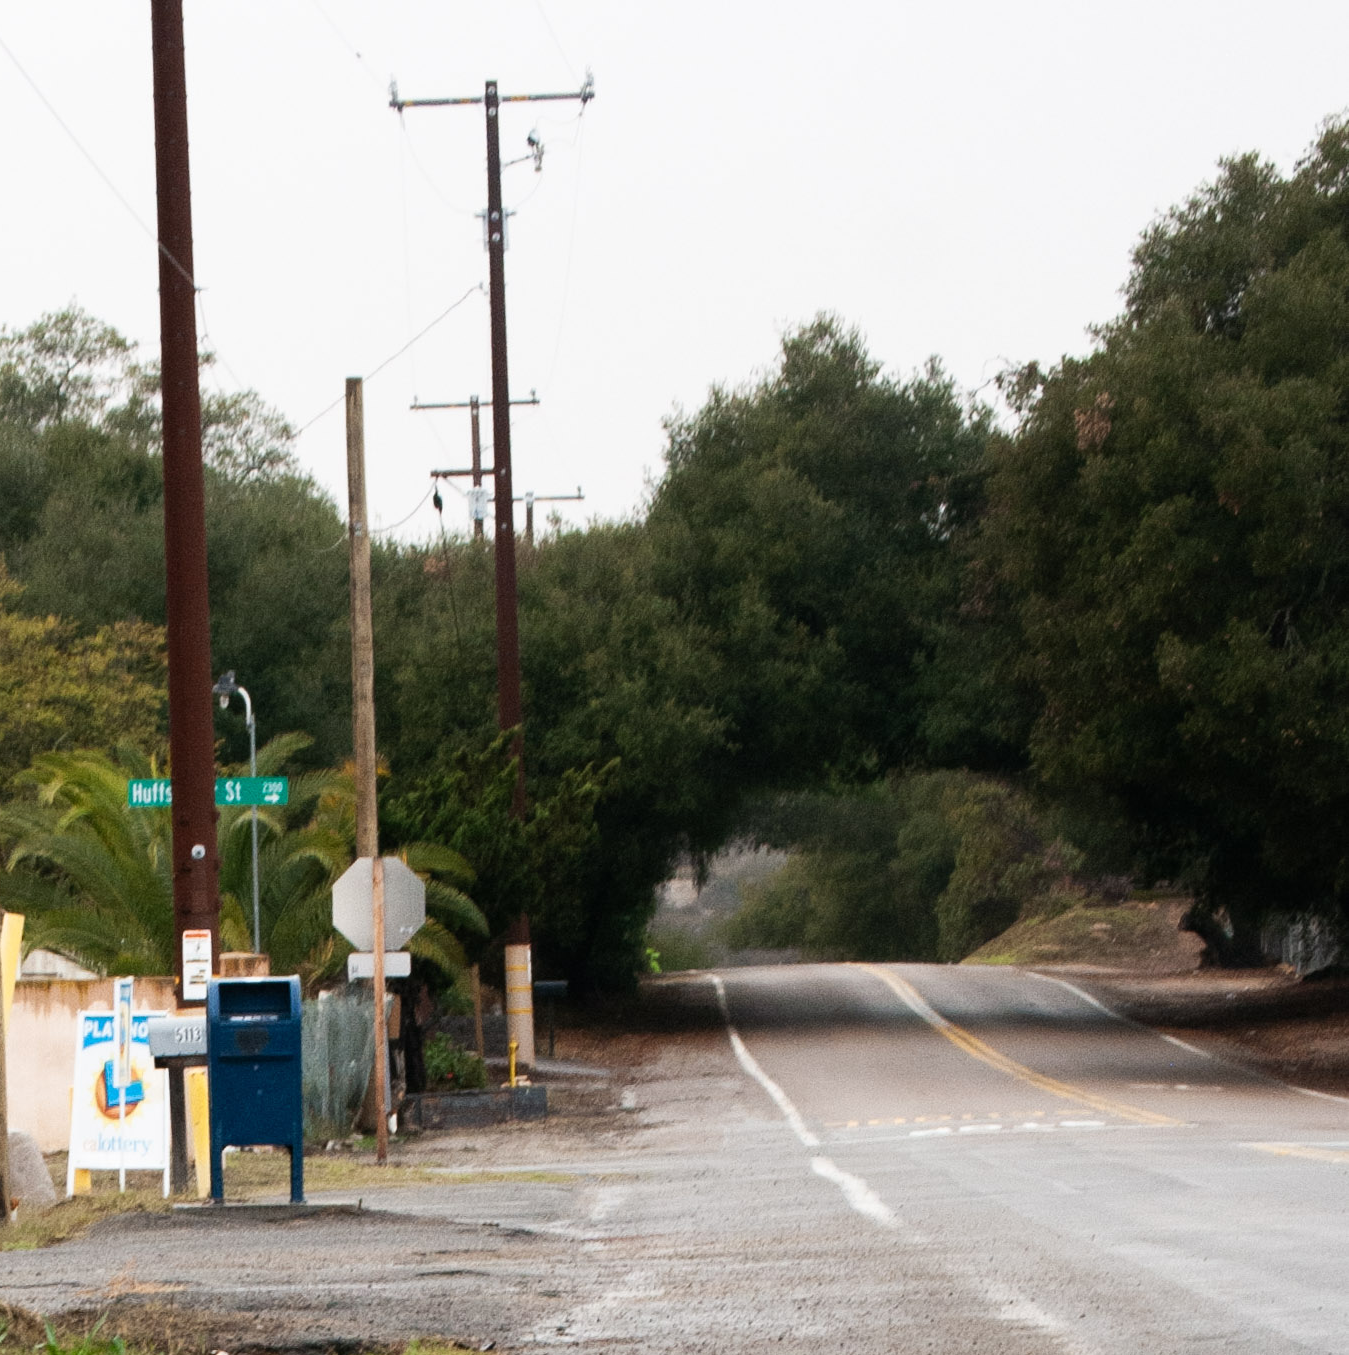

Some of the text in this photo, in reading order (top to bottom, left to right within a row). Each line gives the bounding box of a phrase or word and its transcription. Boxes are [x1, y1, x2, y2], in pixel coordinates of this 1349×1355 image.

[225, 780, 241, 801] St
[84, 1020, 114, 1039] PLA
[82, 1131, 153, 1157] calottery
